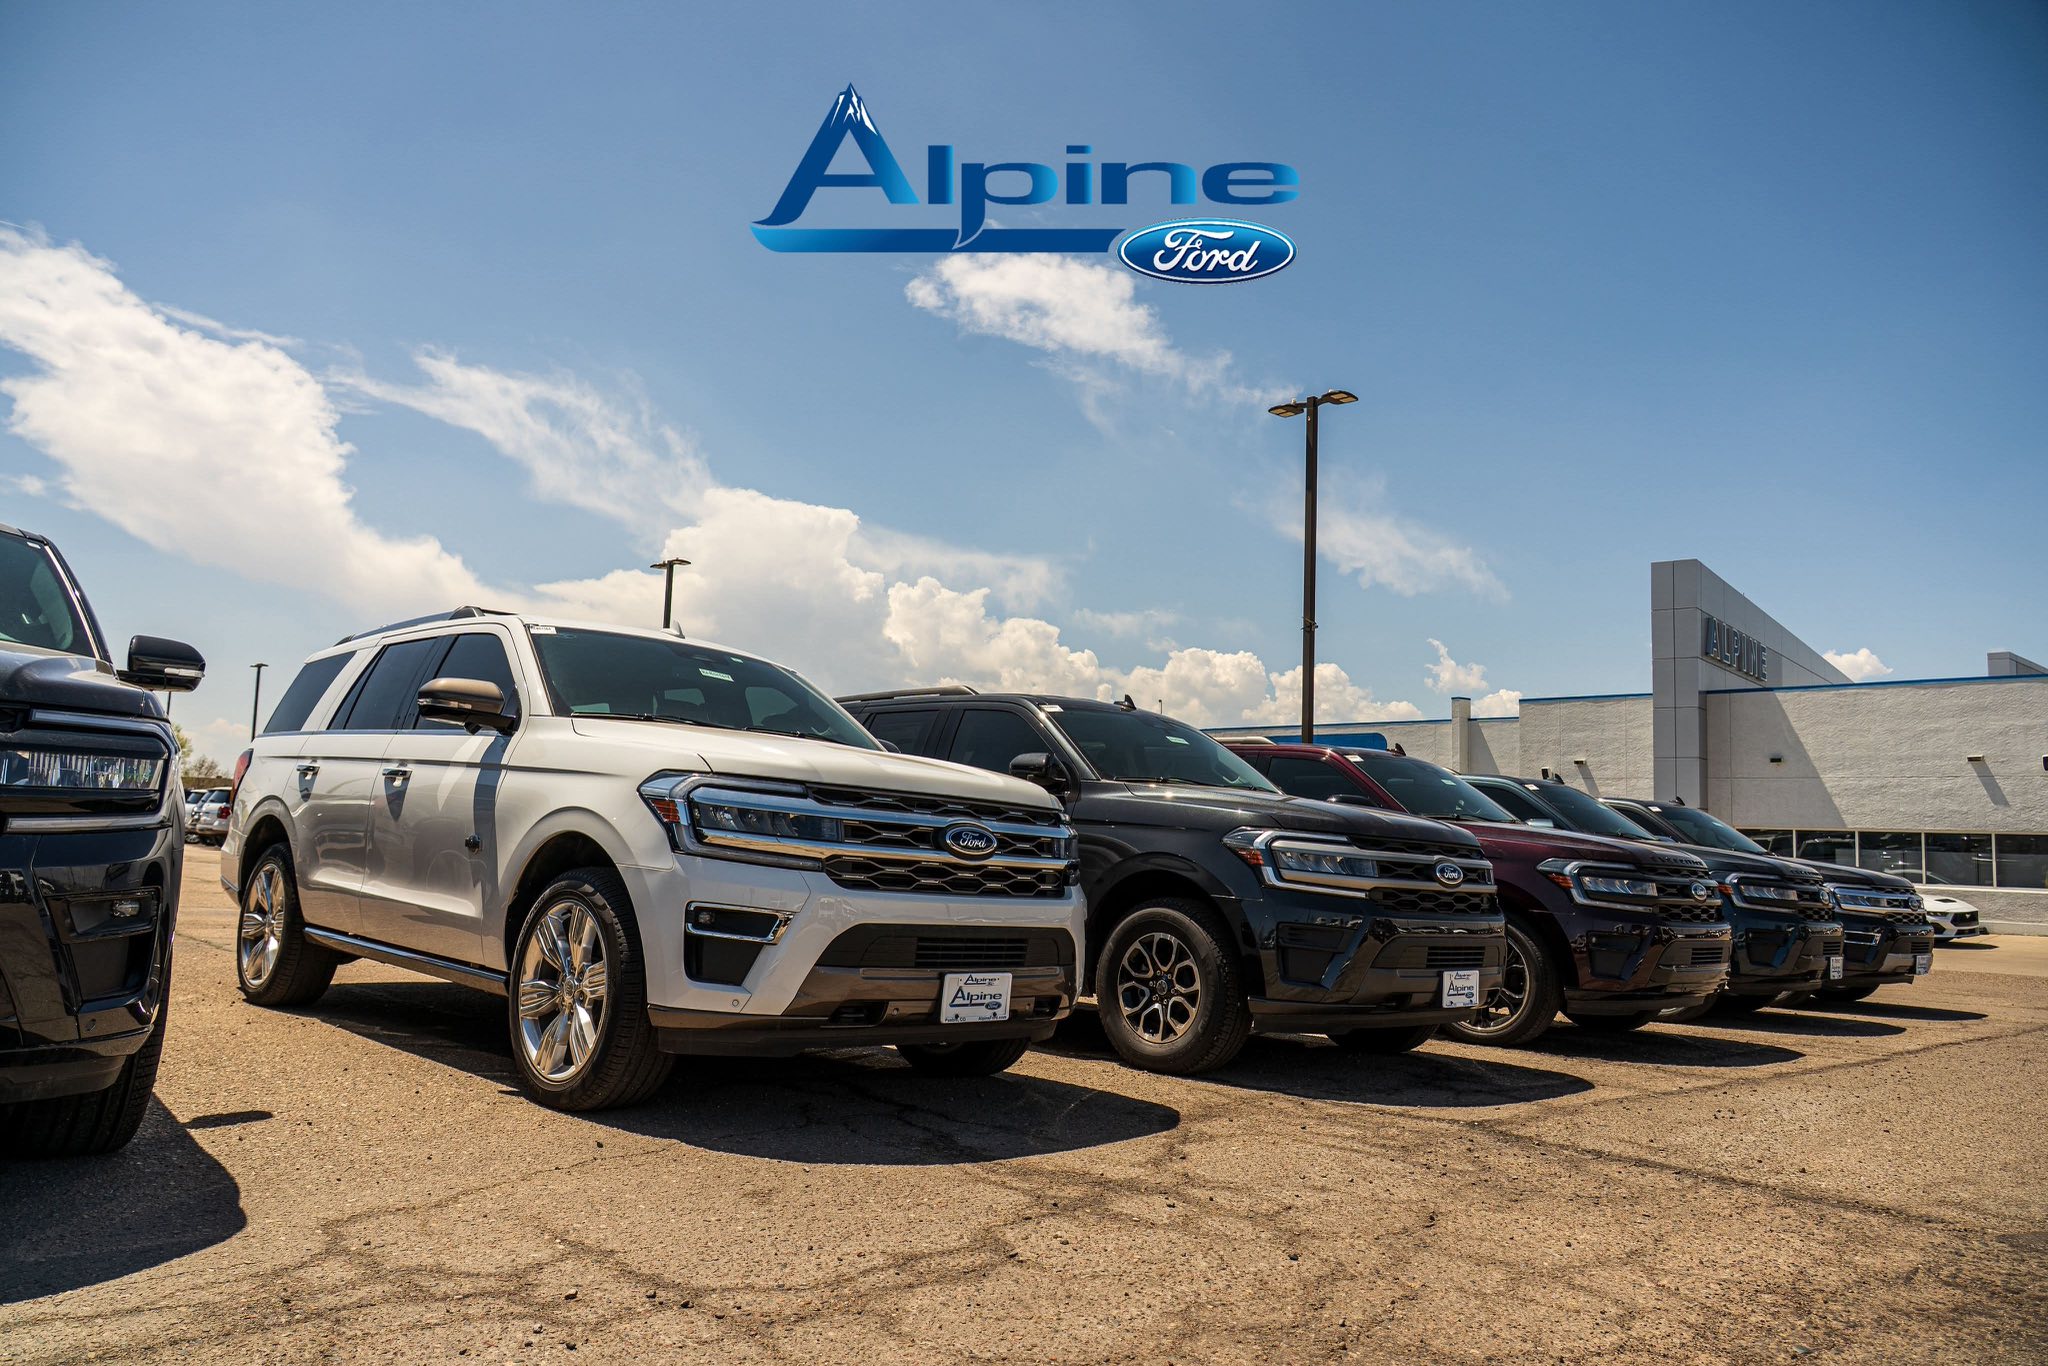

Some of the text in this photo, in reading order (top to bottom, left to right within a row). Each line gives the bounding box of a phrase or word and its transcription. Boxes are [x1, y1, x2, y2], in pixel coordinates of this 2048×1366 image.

[1706, 617, 1767, 682] ALPINE
[960, 831, 987, 848] Ford
[949, 986, 1002, 1006] Alpine
[1447, 980, 1475, 996] Alpine
